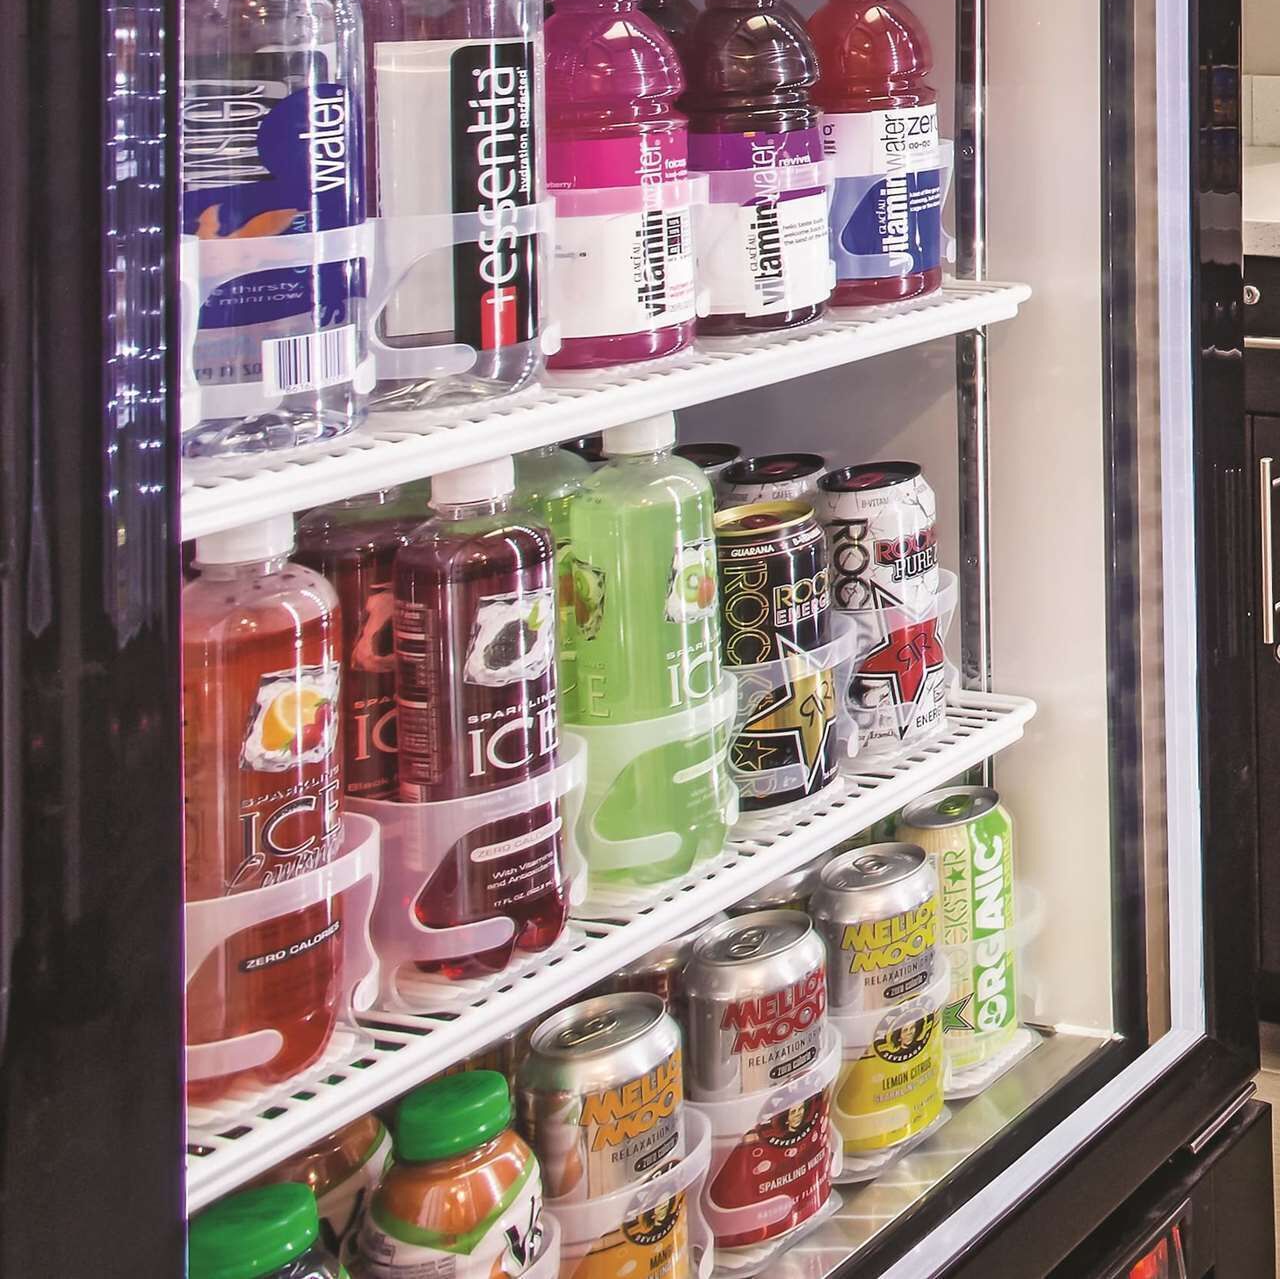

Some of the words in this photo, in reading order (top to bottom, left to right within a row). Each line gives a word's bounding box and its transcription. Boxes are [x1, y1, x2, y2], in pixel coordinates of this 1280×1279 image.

[467, 66, 519, 285] essentia
[778, 152, 811, 168] revive
[731, 545, 775, 558] GUARANA
[467, 702, 560, 778] ICE
[239, 779, 342, 861] ICE
[970, 824, 1007, 1032] ORGANIC
[246, 950, 286, 970] ZERO
[289, 920, 341, 955] CALORIES
[864, 961, 919, 987] RELAXATION
[748, 1039, 805, 1068] RELAXATION
[882, 1075, 909, 1091] LEMON
[910, 1060, 932, 1080] CITRUS
[611, 1128, 671, 1163] RELAXATION
[758, 1164, 807, 1194] SPARKLING
